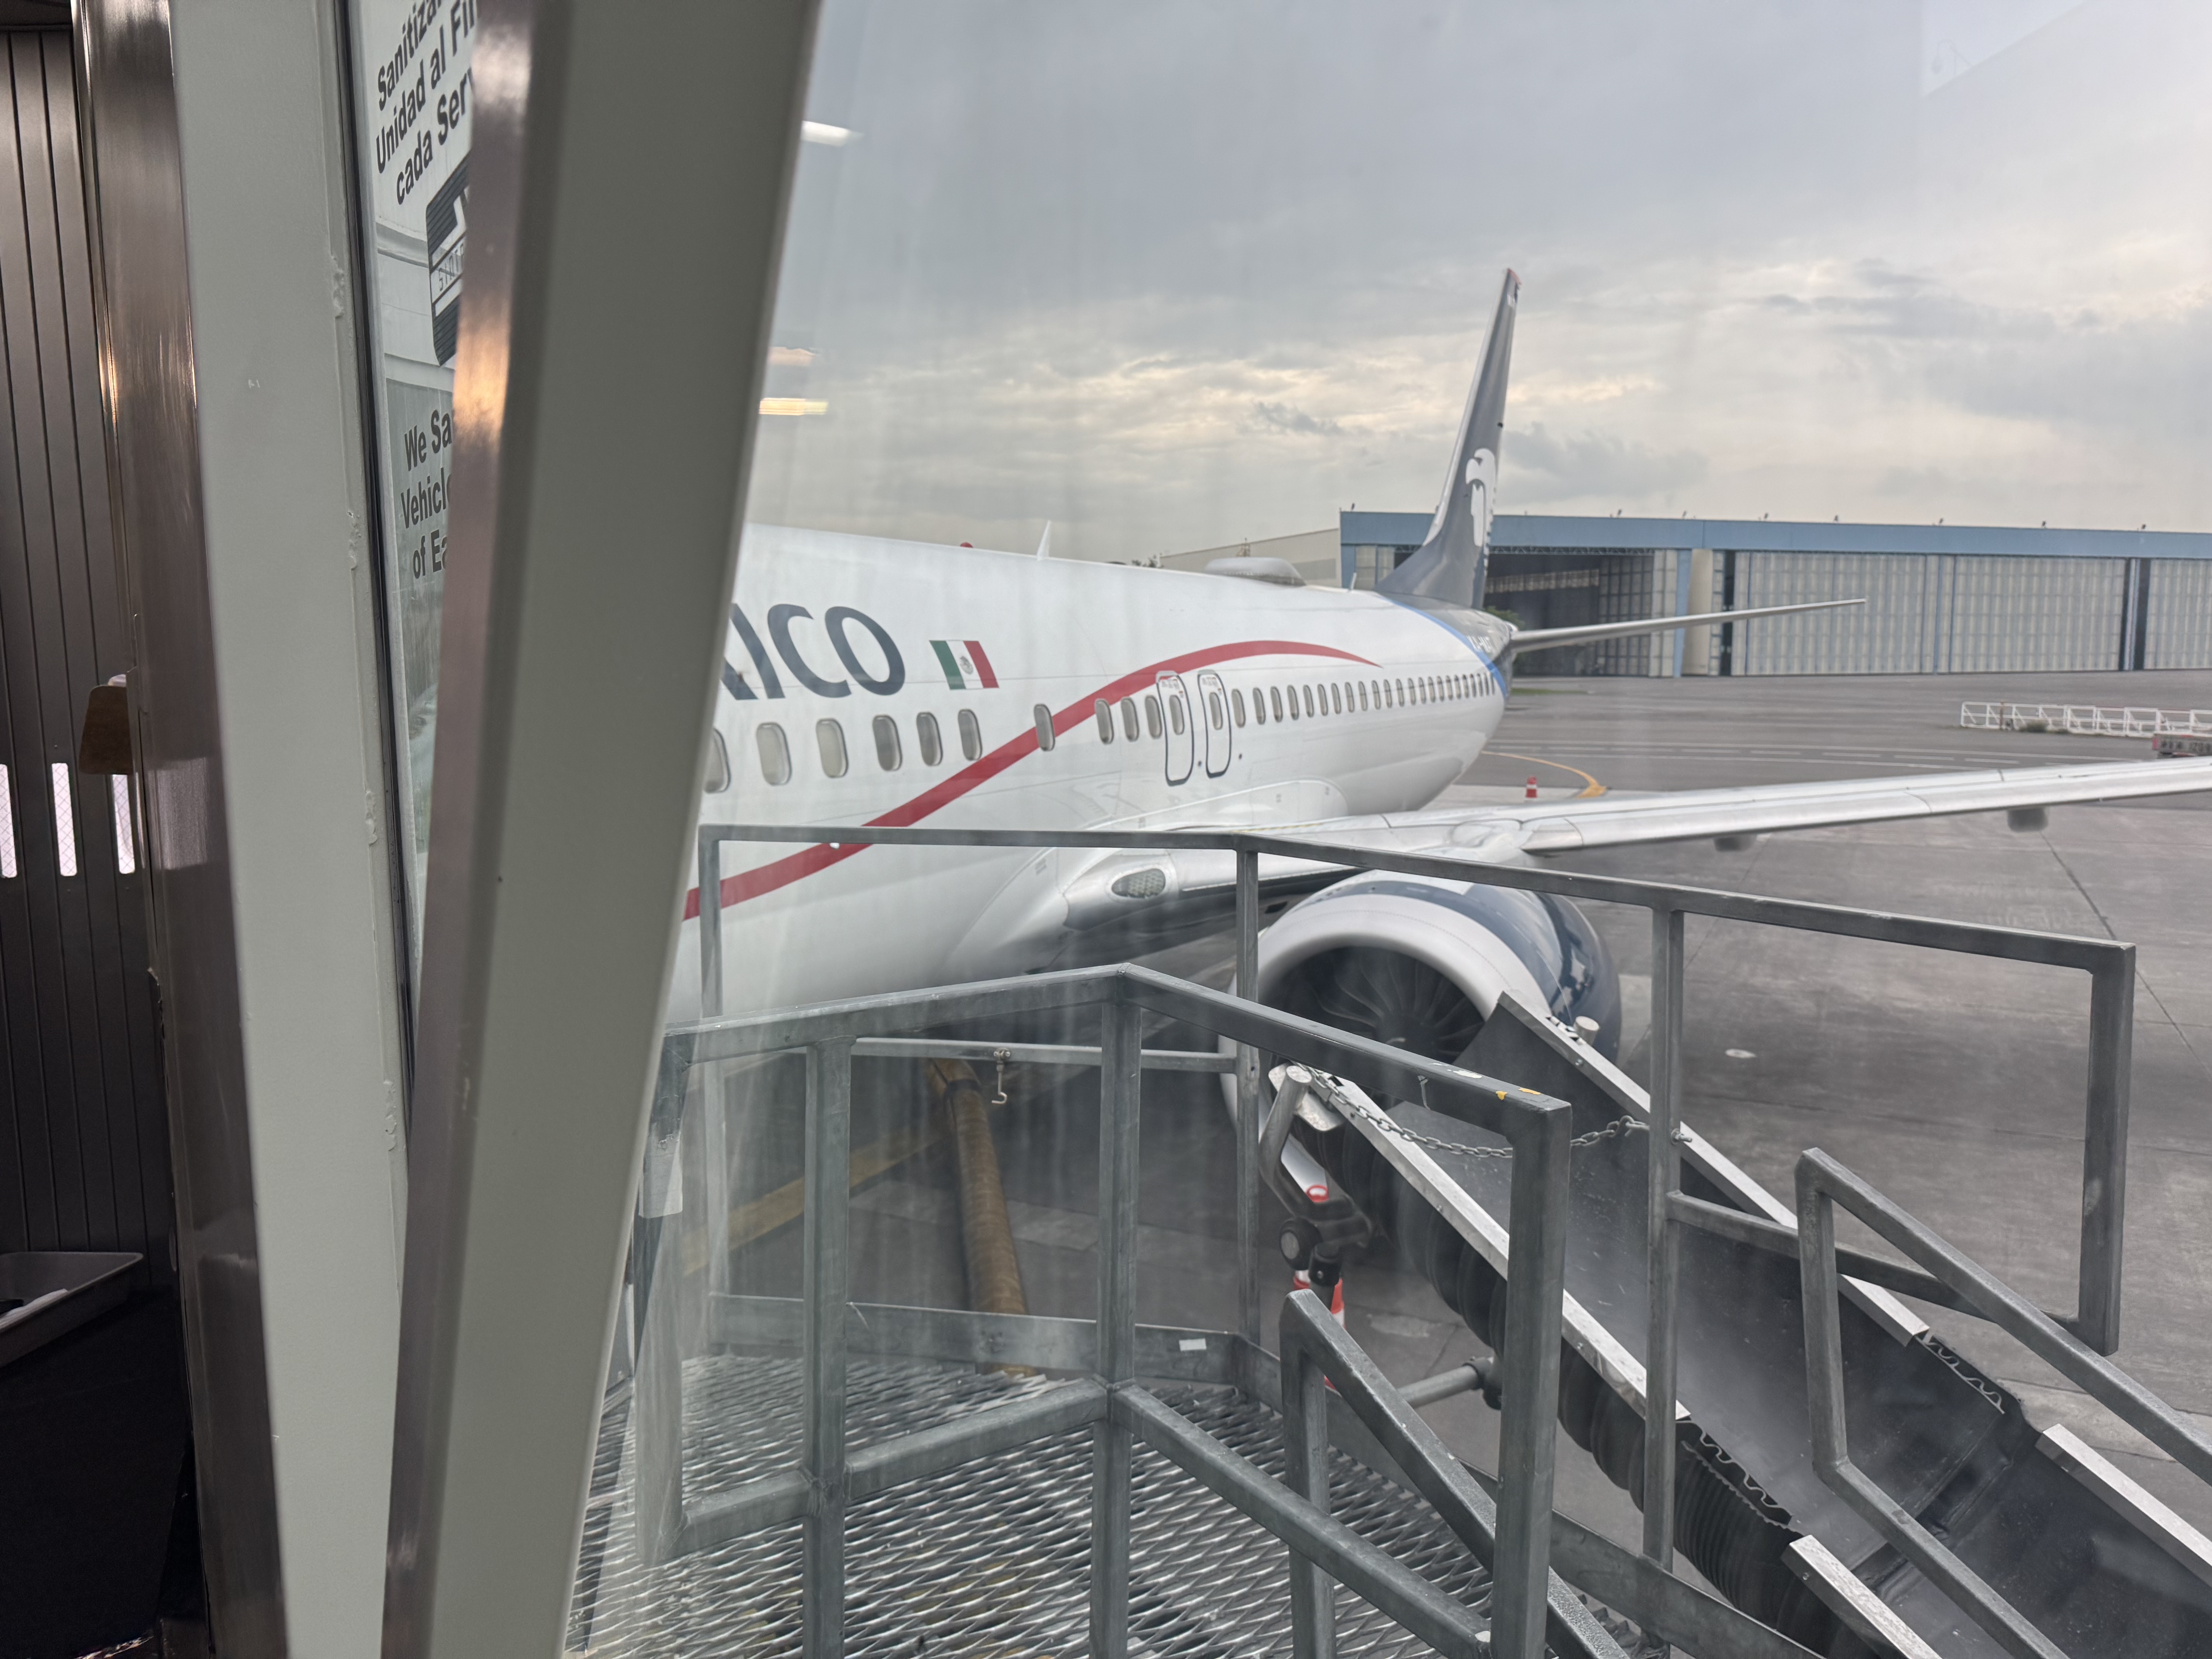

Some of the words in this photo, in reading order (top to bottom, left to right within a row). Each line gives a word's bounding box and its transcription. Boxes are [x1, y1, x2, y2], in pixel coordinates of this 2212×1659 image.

[378, 0, 441, 111] Sanitiza
[376, 58, 426, 174] Unidad
[430, 24, 446, 89] al
[396, 130, 433, 205] cada
[404, 425, 427, 471] We
[431, 409, 454, 454] Sa
[413, 535, 426, 579] of
